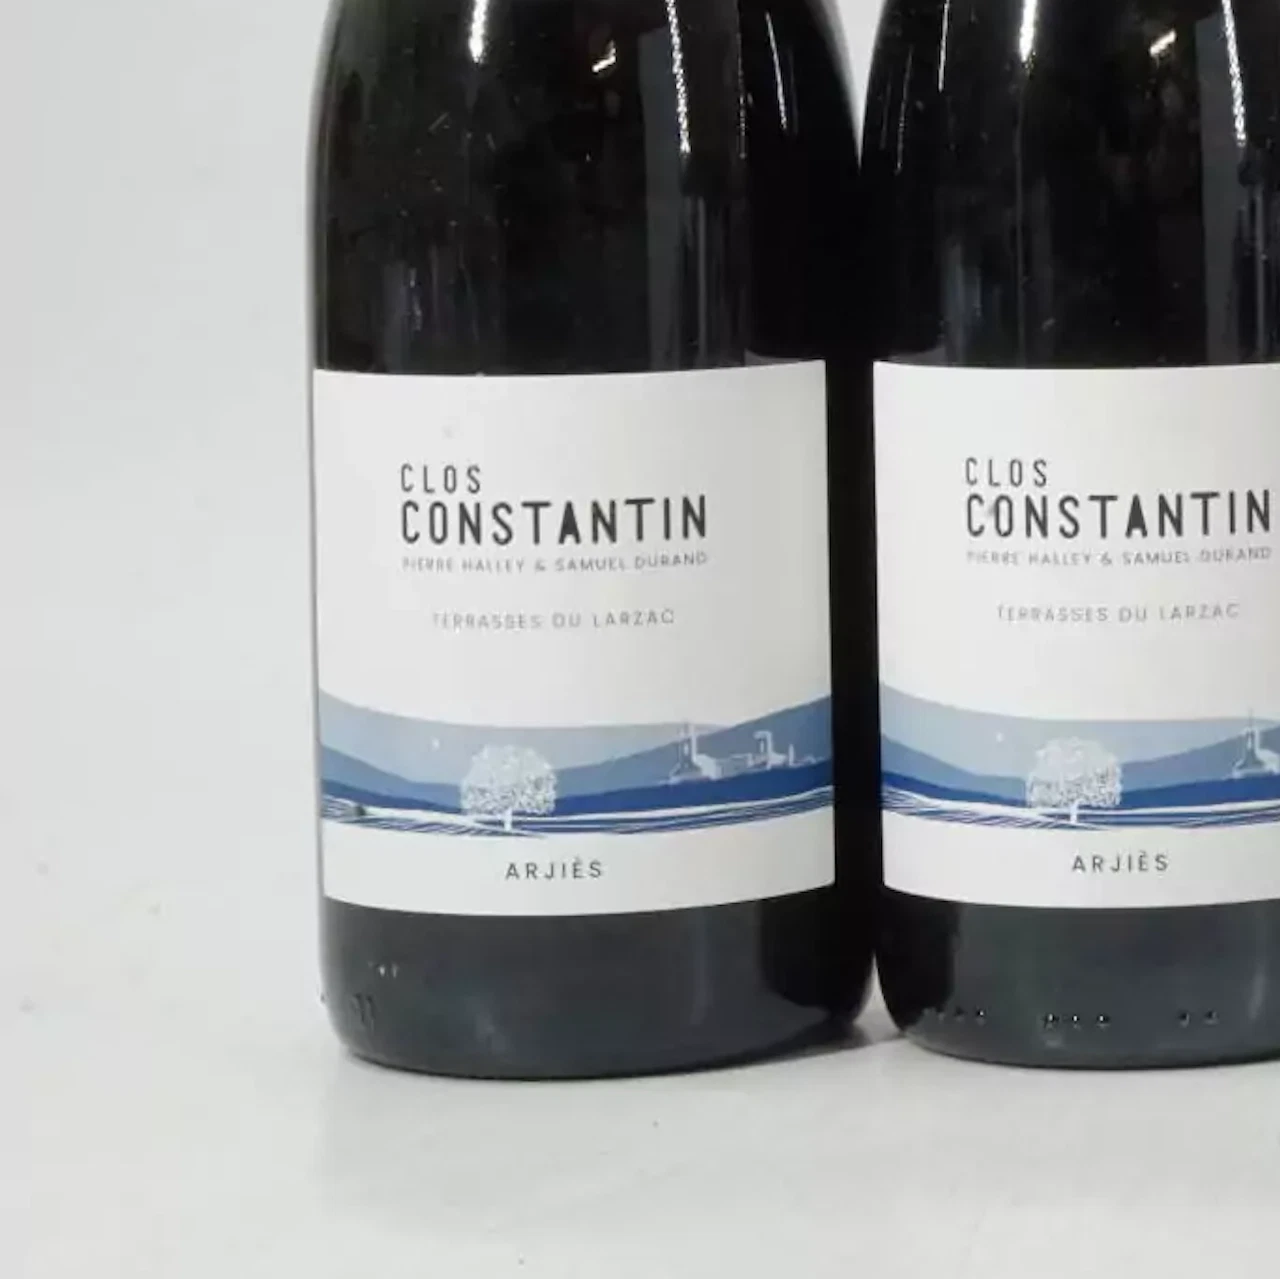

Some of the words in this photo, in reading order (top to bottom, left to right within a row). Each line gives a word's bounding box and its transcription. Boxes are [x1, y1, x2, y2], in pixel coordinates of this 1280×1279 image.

[400, 463, 482, 494] CLOS
[964, 456, 1048, 488] CLOS
[401, 494, 707, 546] CONSTANTIN
[964, 488, 1272, 539] CONSTANTIN
[402, 556, 454, 573] PIERRE
[461, 557, 525, 574] HALLEY
[534, 560, 546, 572] &
[555, 556, 626, 572] SAMUEL
[634, 552, 708, 570] DURAND
[966, 550, 1020, 566] PIERRE
[1028, 549, 1091, 566] HALLEY
[1100, 552, 1113, 567] &
[1122, 550, 1190, 566] SAMUEL
[1199, 545, 1272, 563] DURAND
[433, 611, 542, 632] TERRASSES
[552, 612, 581, 629] DU
[593, 609, 674, 628] LARZAC
[997, 604, 1109, 623] TERRASSES
[1118, 606, 1148, 623] DU
[1159, 602, 1240, 620] LARZAC
[504, 856, 604, 881] ARJIÈS
[1071, 849, 1169, 873] ARJIÈS
